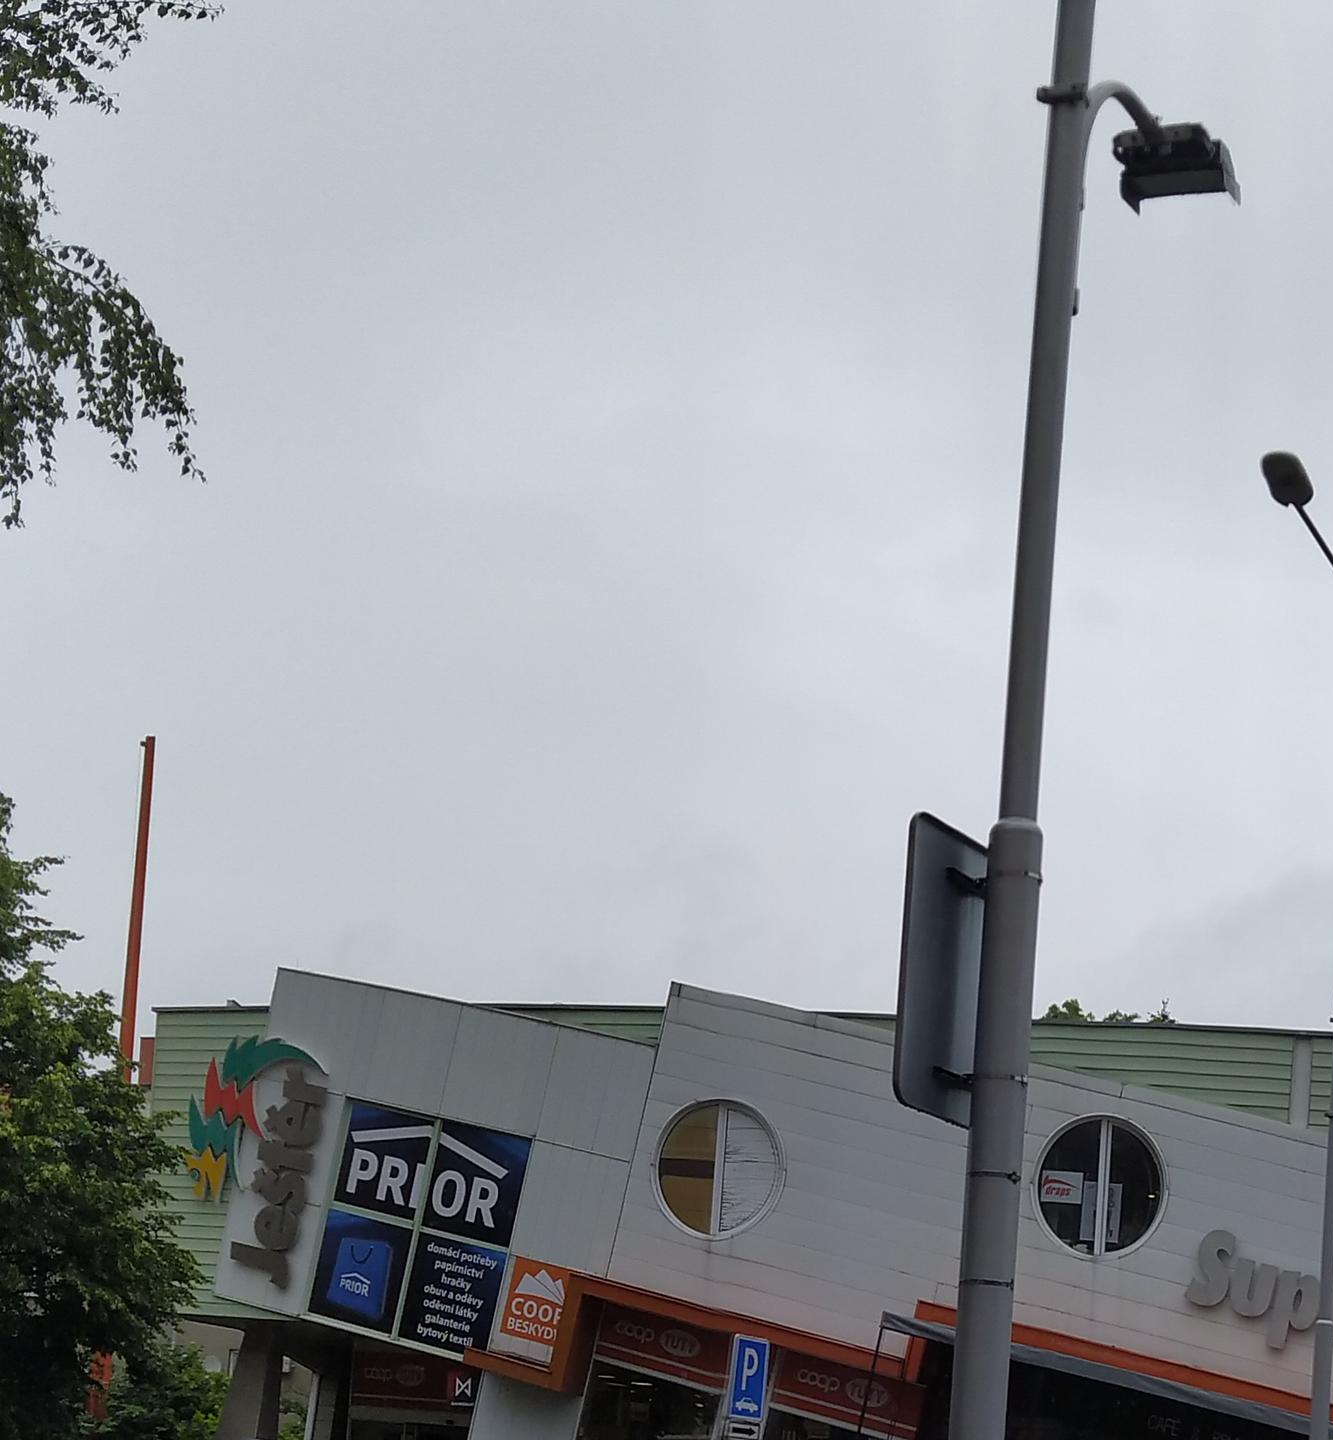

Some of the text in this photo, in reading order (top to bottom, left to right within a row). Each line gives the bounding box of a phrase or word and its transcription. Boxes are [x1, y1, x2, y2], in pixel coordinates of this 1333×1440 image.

[345, 1147, 499, 1228] PRIOR
[427, 1242, 498, 1270] domácí potřeby
[434, 1259, 485, 1280] papírnictví
[339, 1278, 370, 1297] PRIOR
[441, 1273, 472, 1292] hračky
[423, 1284, 447, 1297] obuv
[455, 1292, 484, 1309] oděvy
[423, 1298, 479, 1322] oděvní látky
[416, 1323, 449, 1341] bytový
[424, 1314, 471, 1333] galanterie
[742, 1347, 759, 1390] P
[797, 1368, 841, 1393] coop
